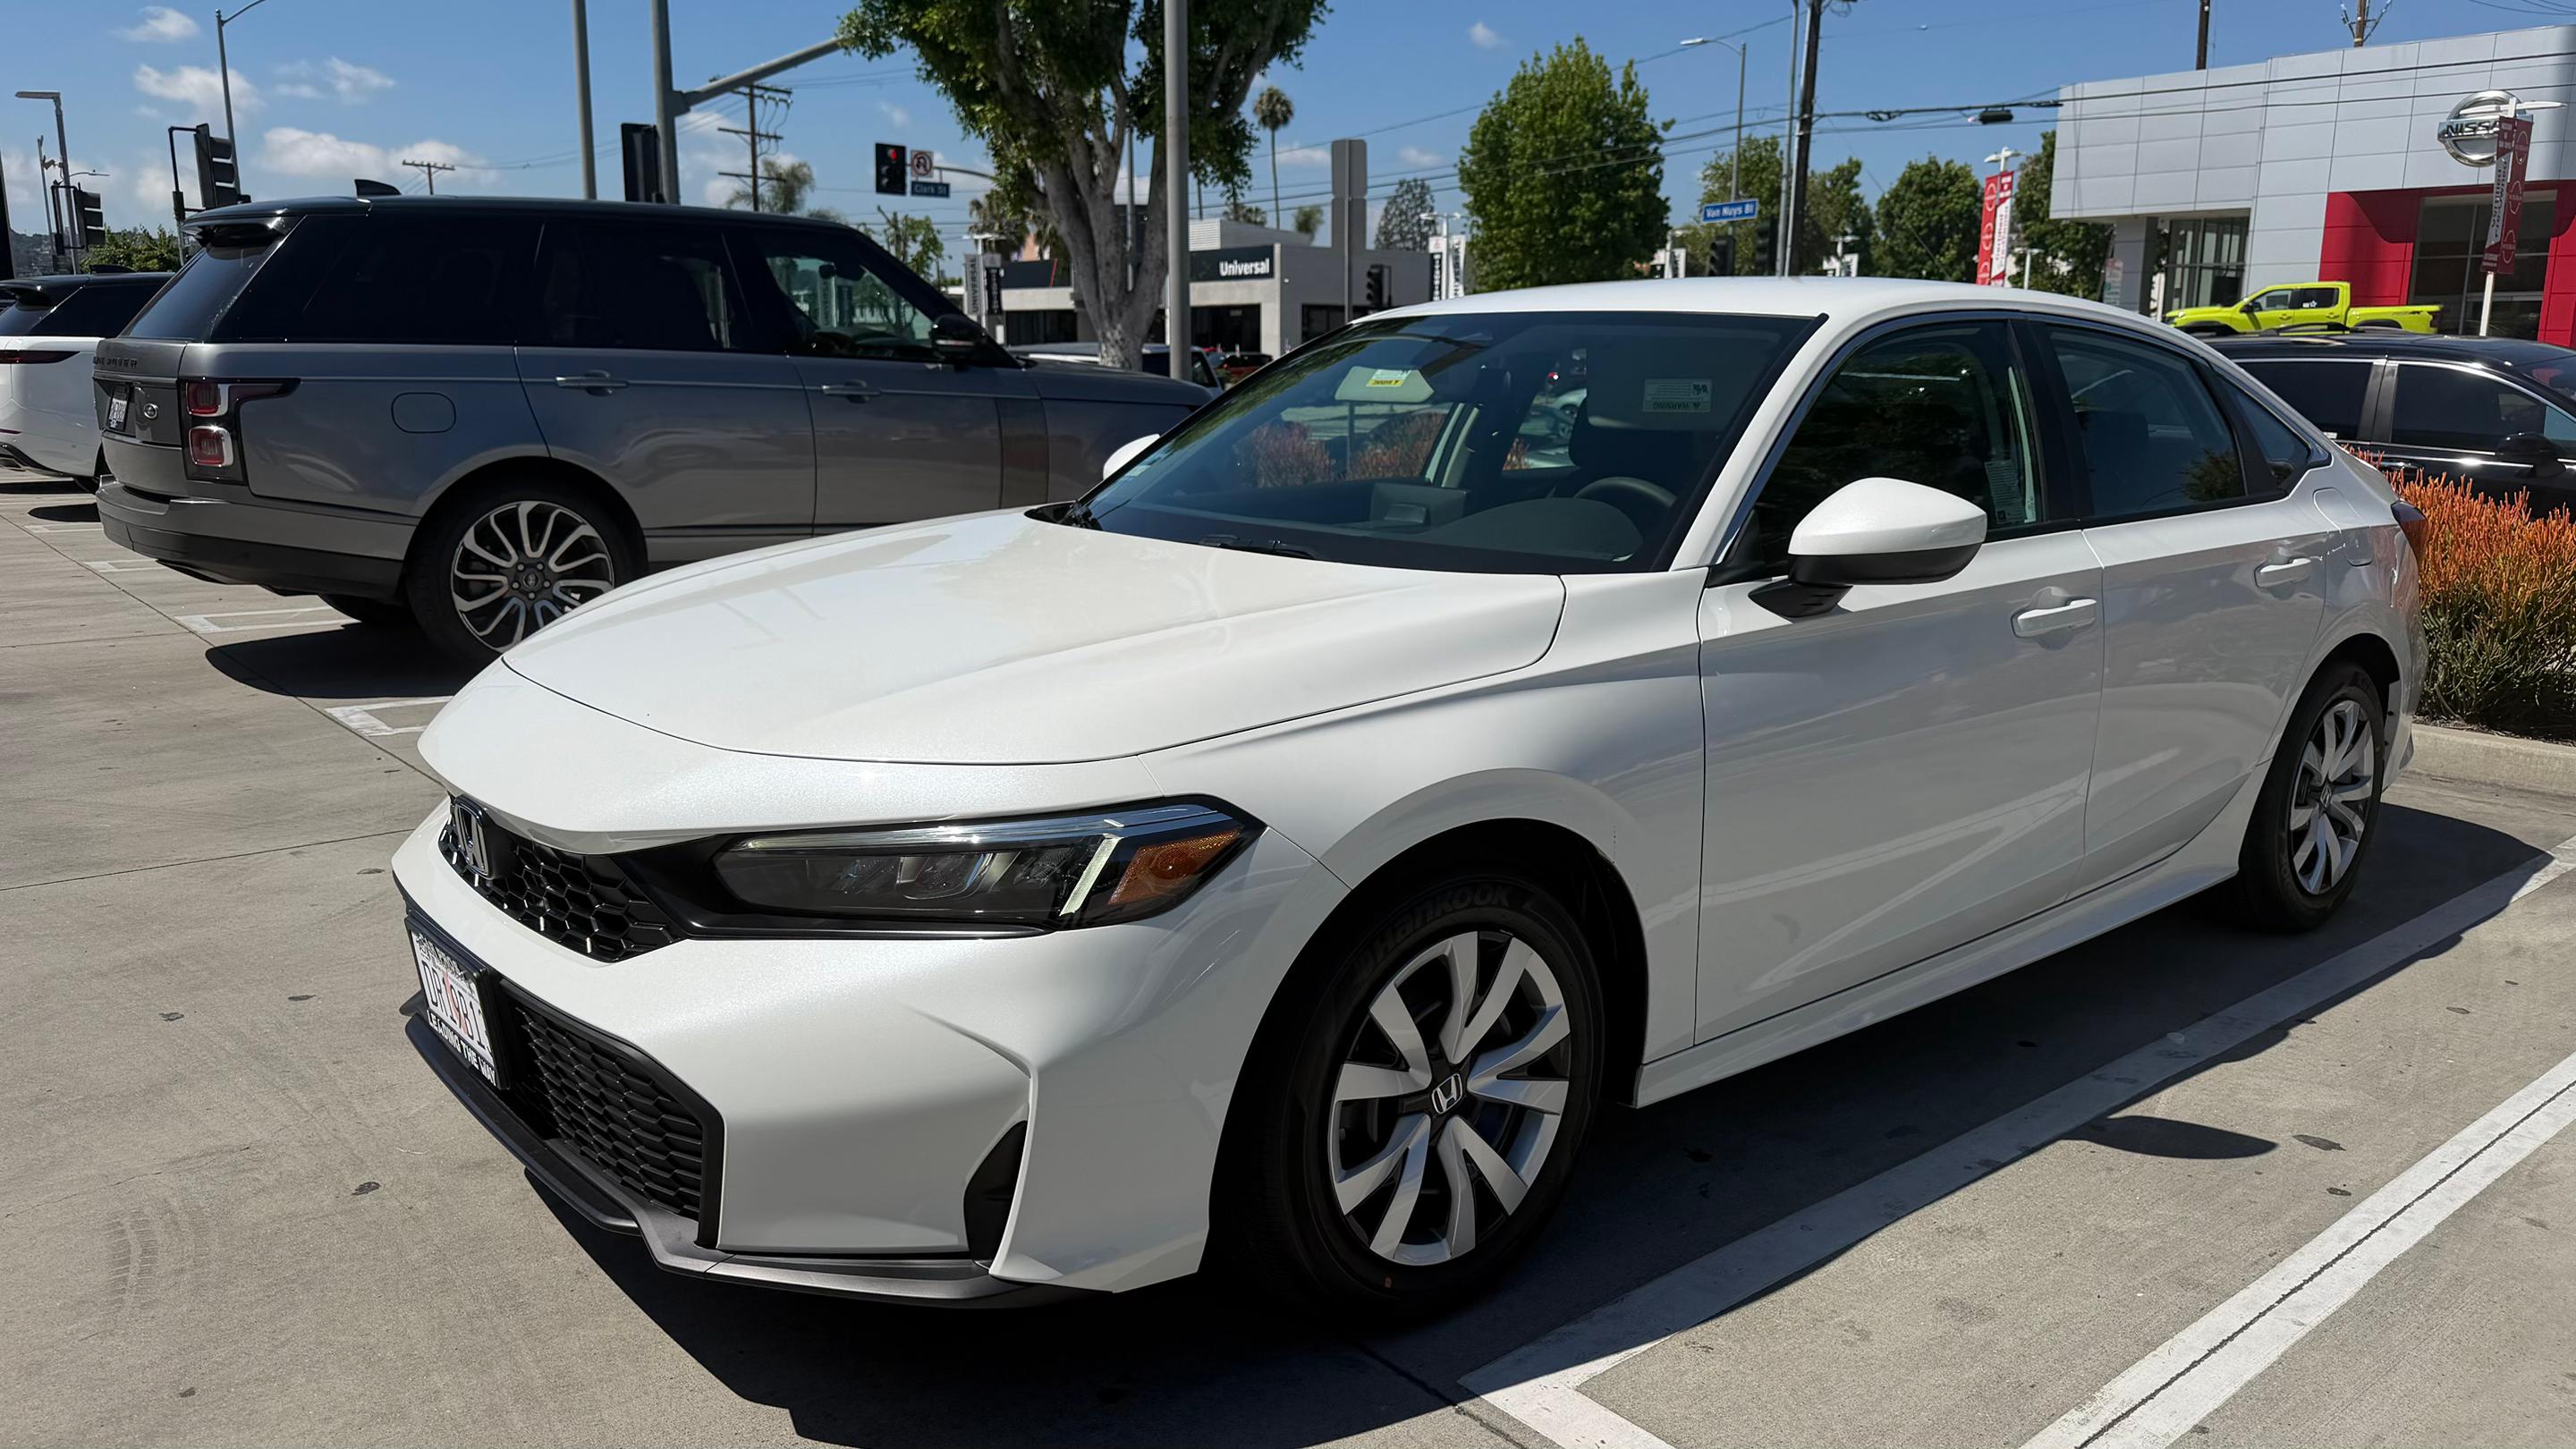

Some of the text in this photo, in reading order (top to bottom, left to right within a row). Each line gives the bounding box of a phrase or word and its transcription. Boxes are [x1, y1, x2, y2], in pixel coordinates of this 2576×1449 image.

[2445, 121, 2500, 137] NISSA
[1706, 207, 1721, 217] Van
[1722, 205, 1743, 217] Nuys
[1218, 257, 1270, 276] Universal
[970, 258, 979, 314] UNIVERSAL
[422, 960, 491, 1053] DR19B1
[427, 1009, 497, 1087] LEADING THE WAY
